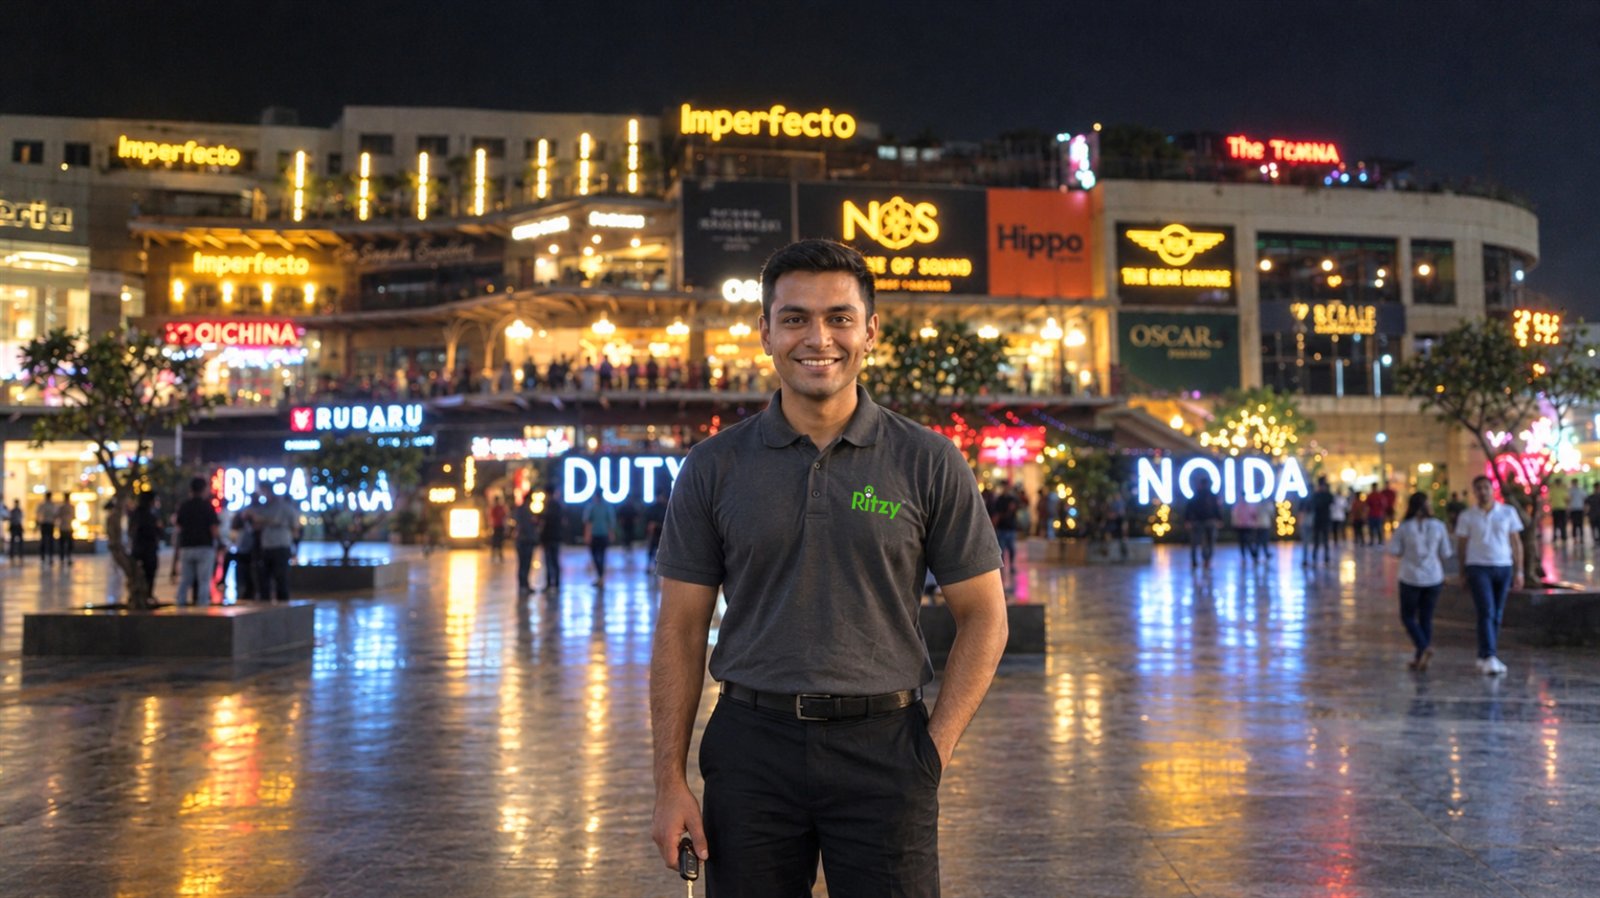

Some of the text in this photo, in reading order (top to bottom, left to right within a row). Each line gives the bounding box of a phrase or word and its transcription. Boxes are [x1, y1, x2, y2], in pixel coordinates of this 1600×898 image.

[680, 103, 856, 141] Imperfecto
[117, 134, 241, 168] Imperfecto
[1226, 134, 1266, 160] The
[997, 222, 1085, 257] Hippo
[192, 251, 310, 278] Imperfecto
[891, 257, 915, 275] OF
[918, 258, 972, 277] SOUND
[1121, 267, 1148, 285] THE
[315, 402, 423, 426] RUBARU
[563, 456, 688, 504] DUTY
[1136, 456, 1309, 505] NOIDA
[851, 485, 902, 520] Ritzy
